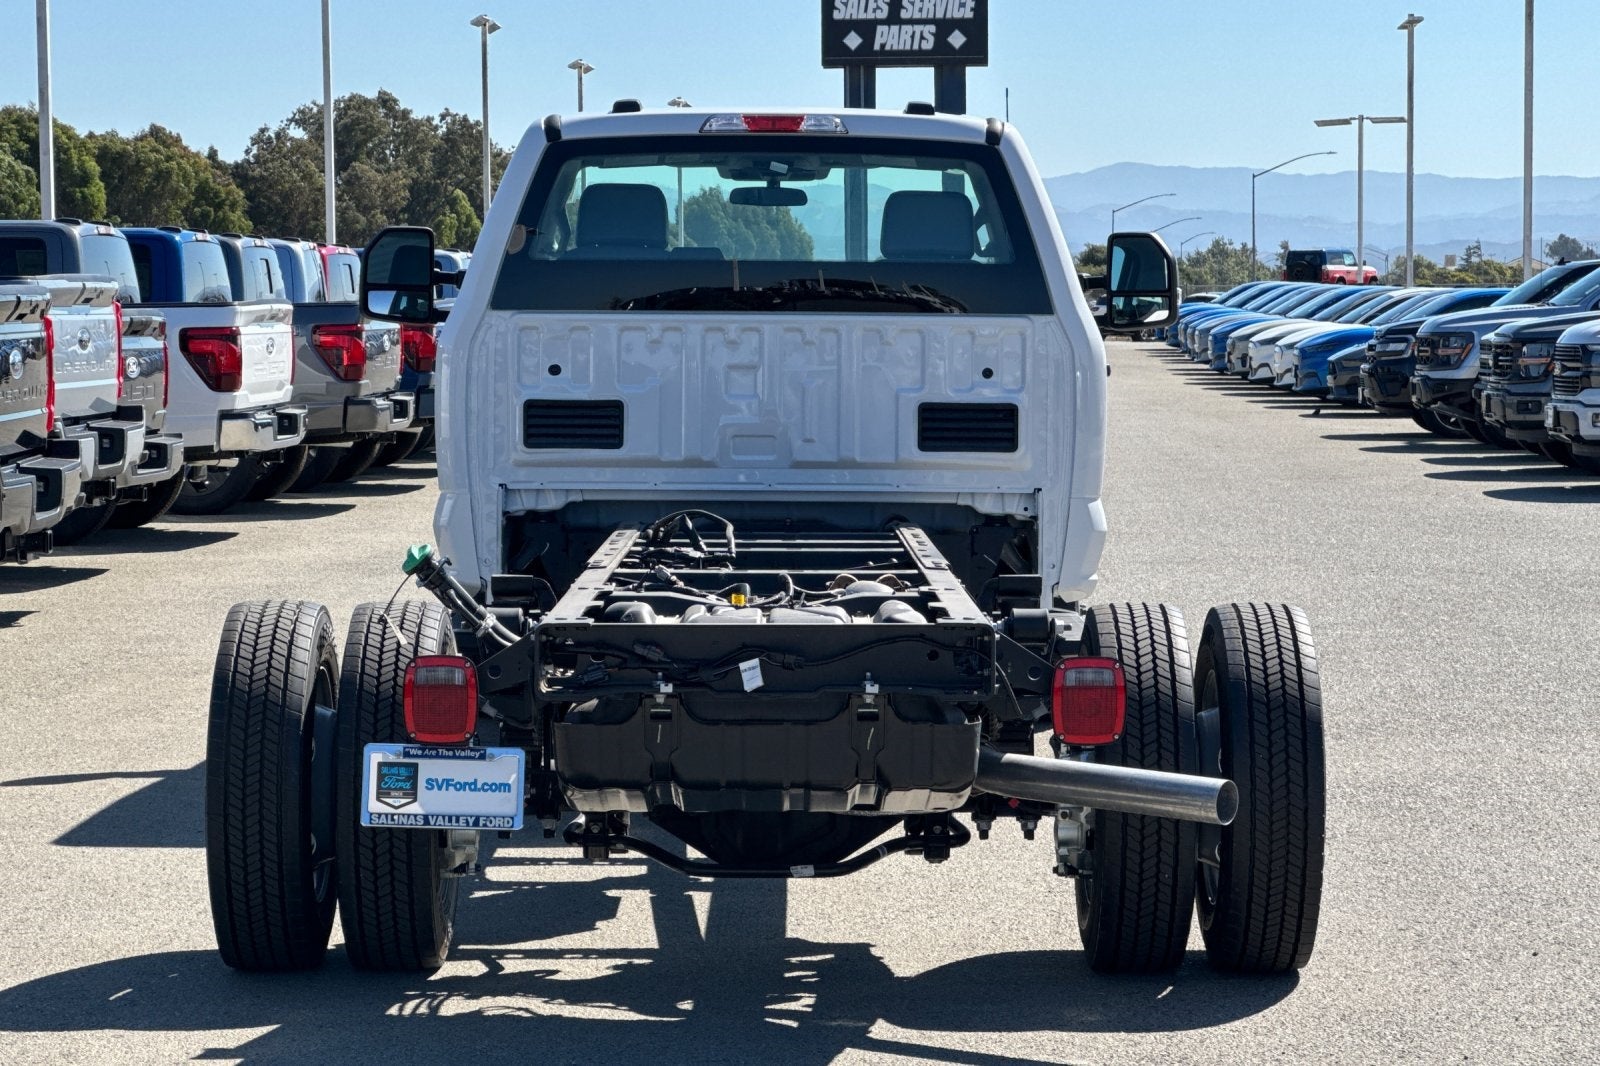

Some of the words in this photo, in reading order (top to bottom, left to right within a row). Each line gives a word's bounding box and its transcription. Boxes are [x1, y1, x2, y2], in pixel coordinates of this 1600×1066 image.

[832, 0, 890, 20] SALES
[899, 0, 975, 20] SERVICE
[873, 24, 937, 51] PARTS
[437, 749, 453, 757] The
[381, 775, 413, 789] Ford
[424, 777, 512, 793] SVFord.com
[371, 814, 424, 826] SALINAS
[428, 816, 475, 827] VALLEY
[479, 816, 513, 828] FORD
